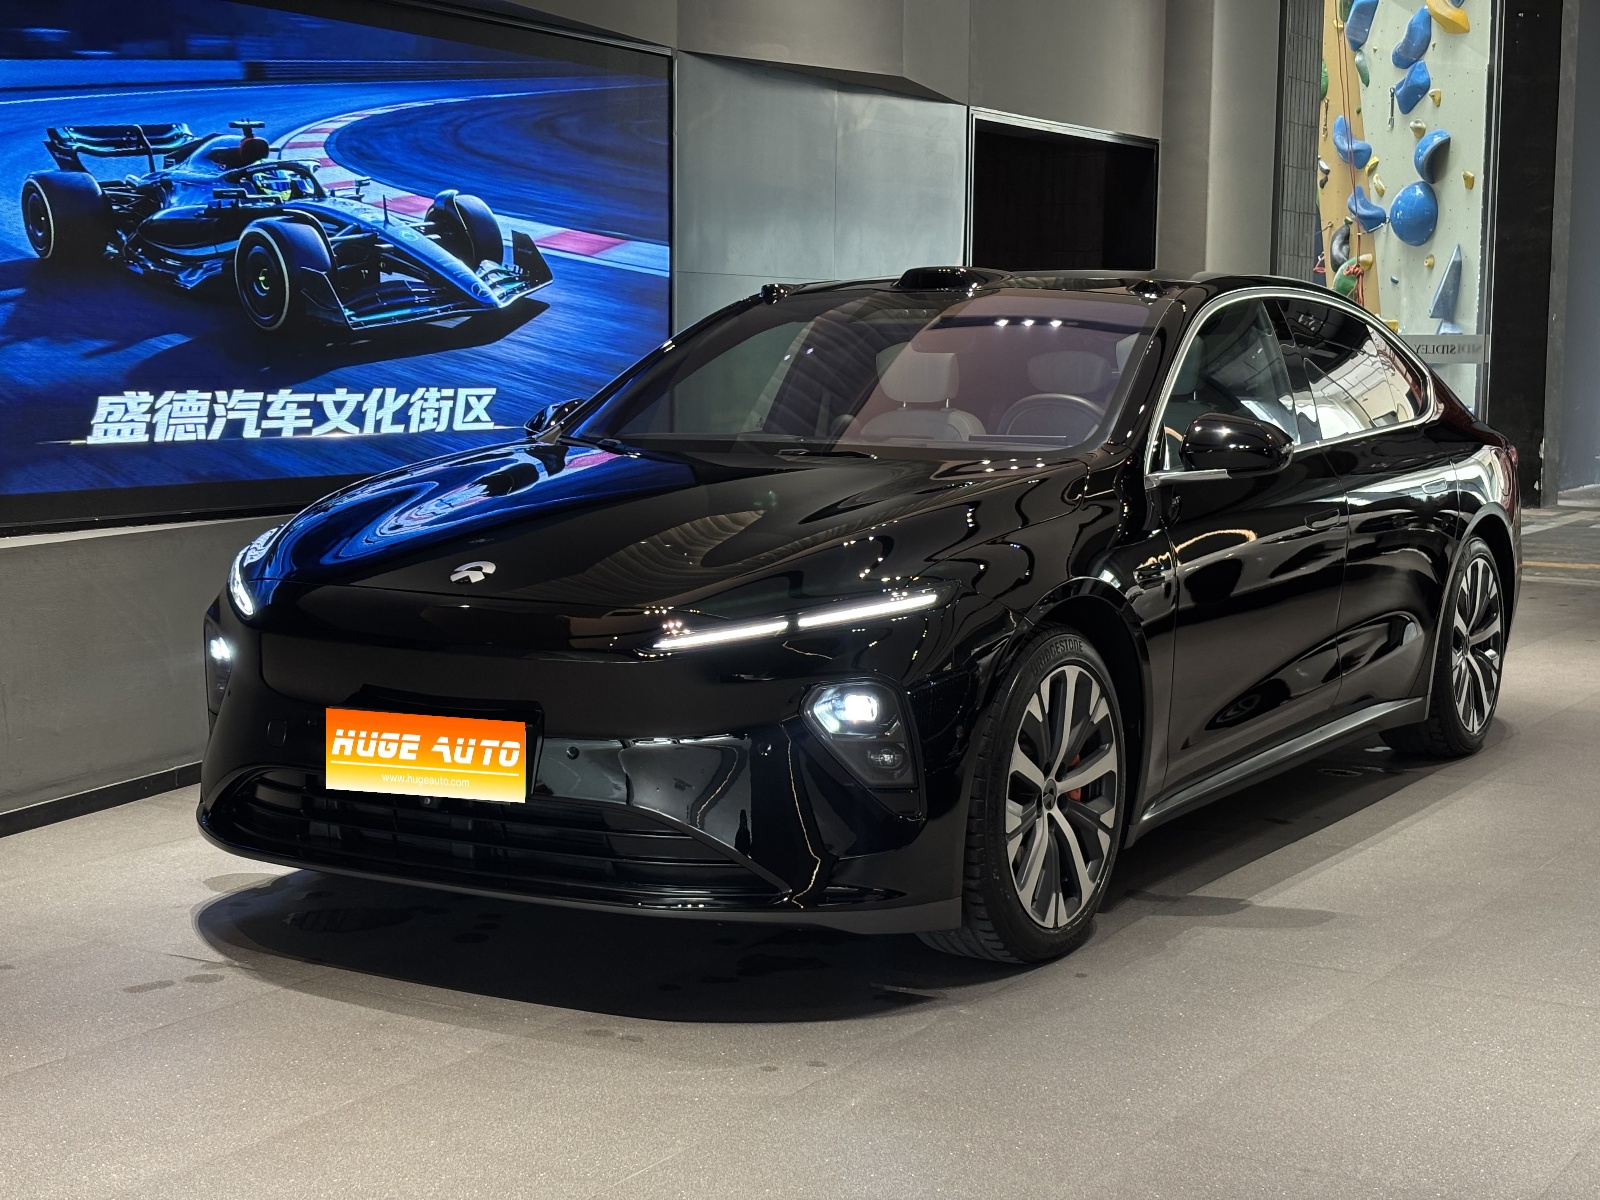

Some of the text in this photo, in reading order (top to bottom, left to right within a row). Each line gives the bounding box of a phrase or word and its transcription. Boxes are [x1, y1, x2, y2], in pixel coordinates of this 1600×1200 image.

[86, 387, 498, 444] 盛德汽车文化街区
[1030, 638, 1084, 676] BRIDGESTONE
